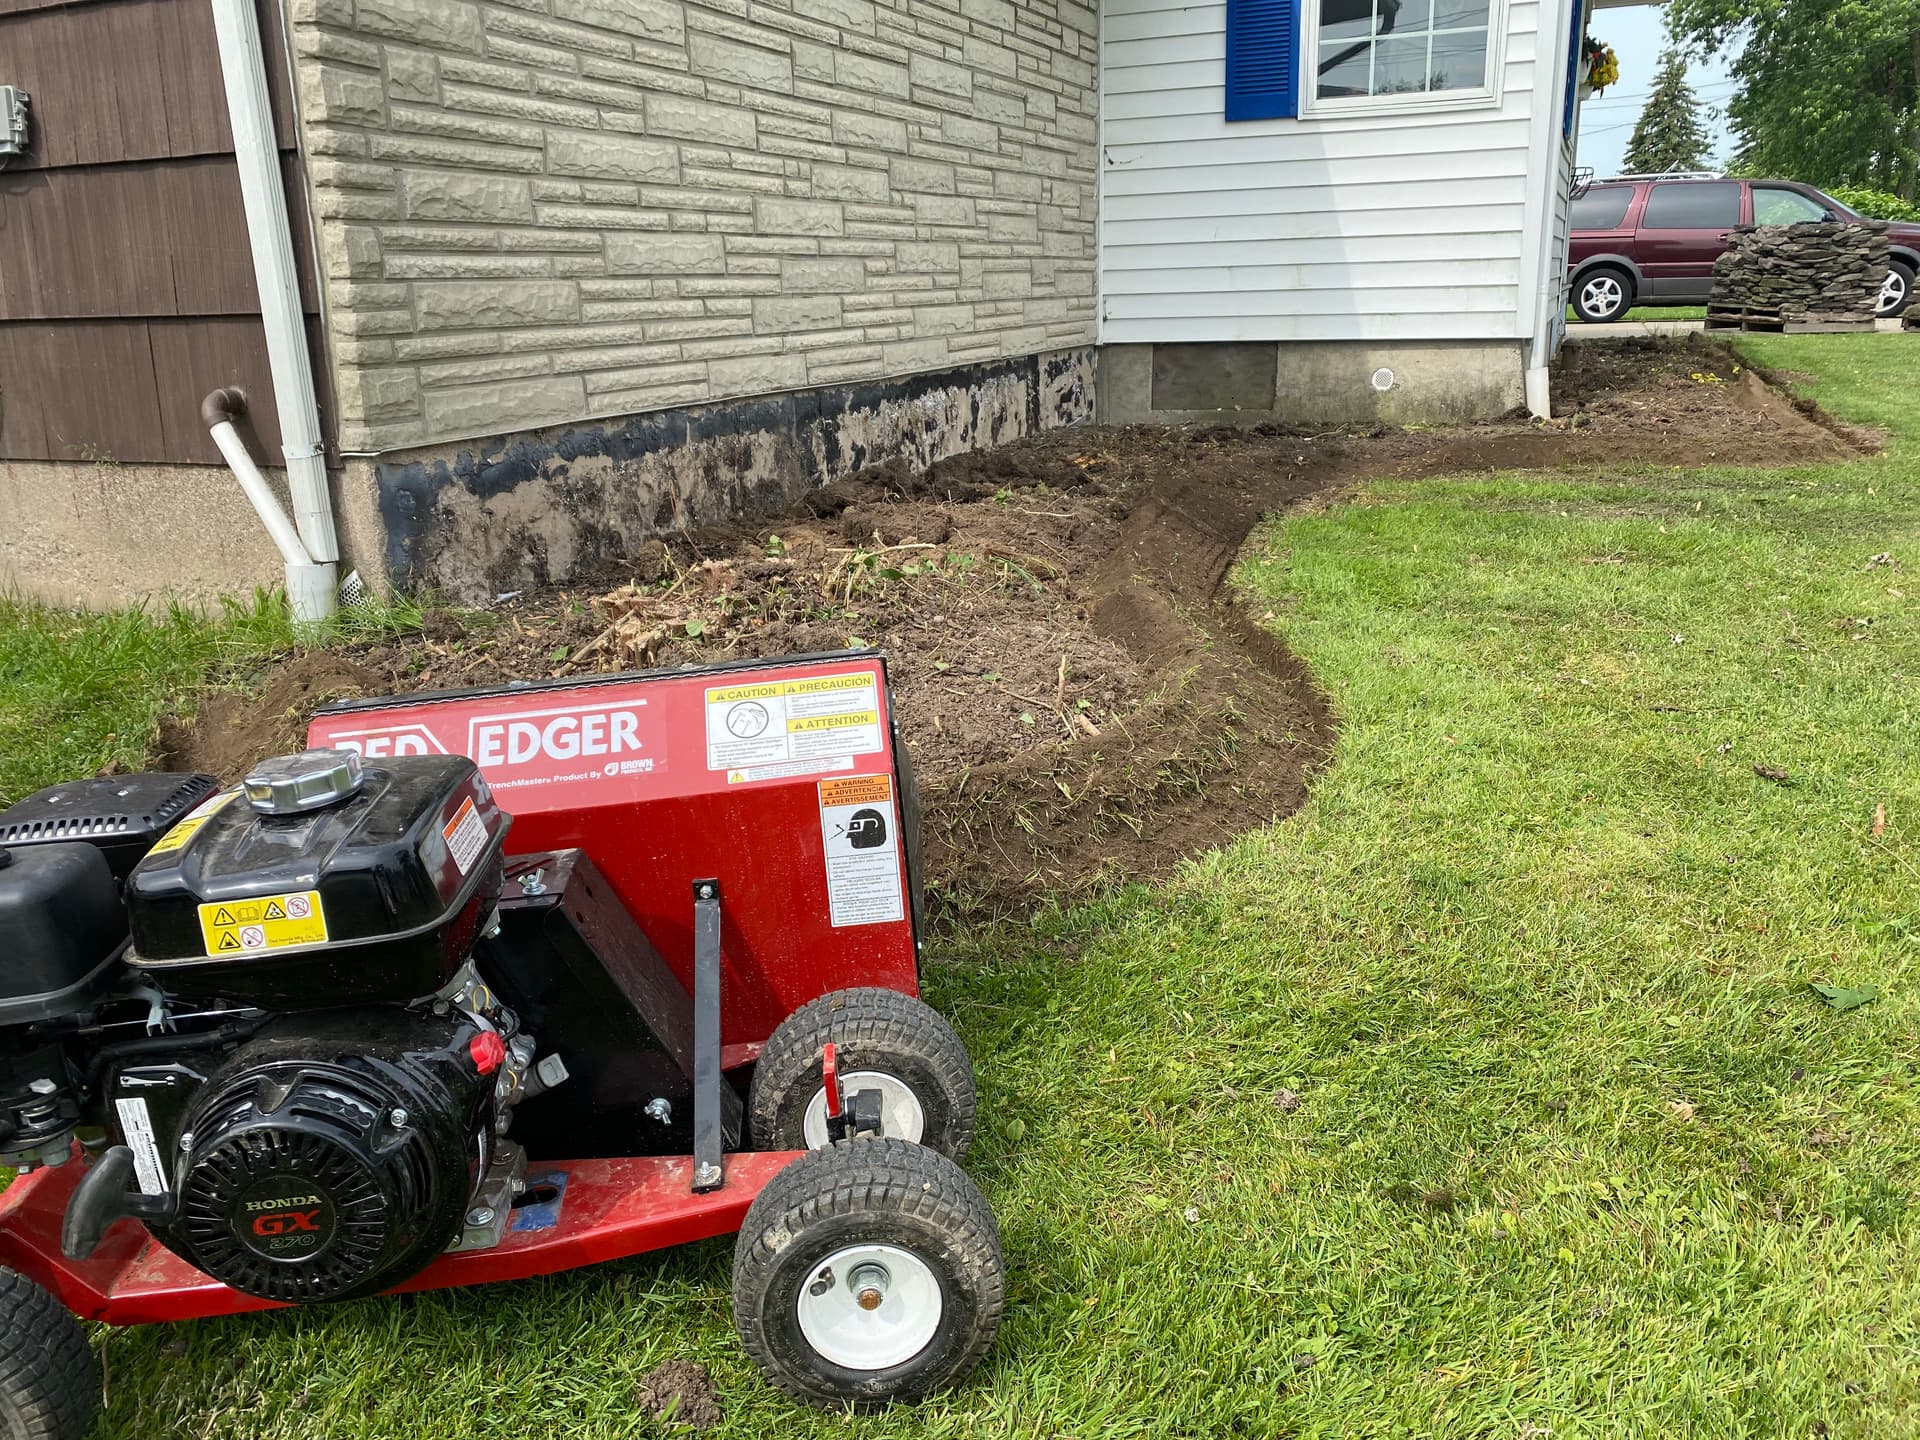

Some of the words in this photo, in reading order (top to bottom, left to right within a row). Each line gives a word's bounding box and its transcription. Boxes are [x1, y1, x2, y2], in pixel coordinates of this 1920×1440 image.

[727, 687, 777, 700] CAUTION
[806, 714, 869, 729] ATTENTION
[478, 711, 642, 767] EDGER
[620, 758, 653, 769] BROWN
[553, 772, 588, 783] Product
[589, 771, 602, 780] By
[841, 778, 875, 787] WARNING
[834, 786, 884, 796] ADVERTENCIA
[831, 793, 889, 805] AVERTISSEMENT
[245, 1195, 322, 1211] HONDA
[253, 1210, 321, 1235] GX
[269, 1235, 316, 1249] 270
